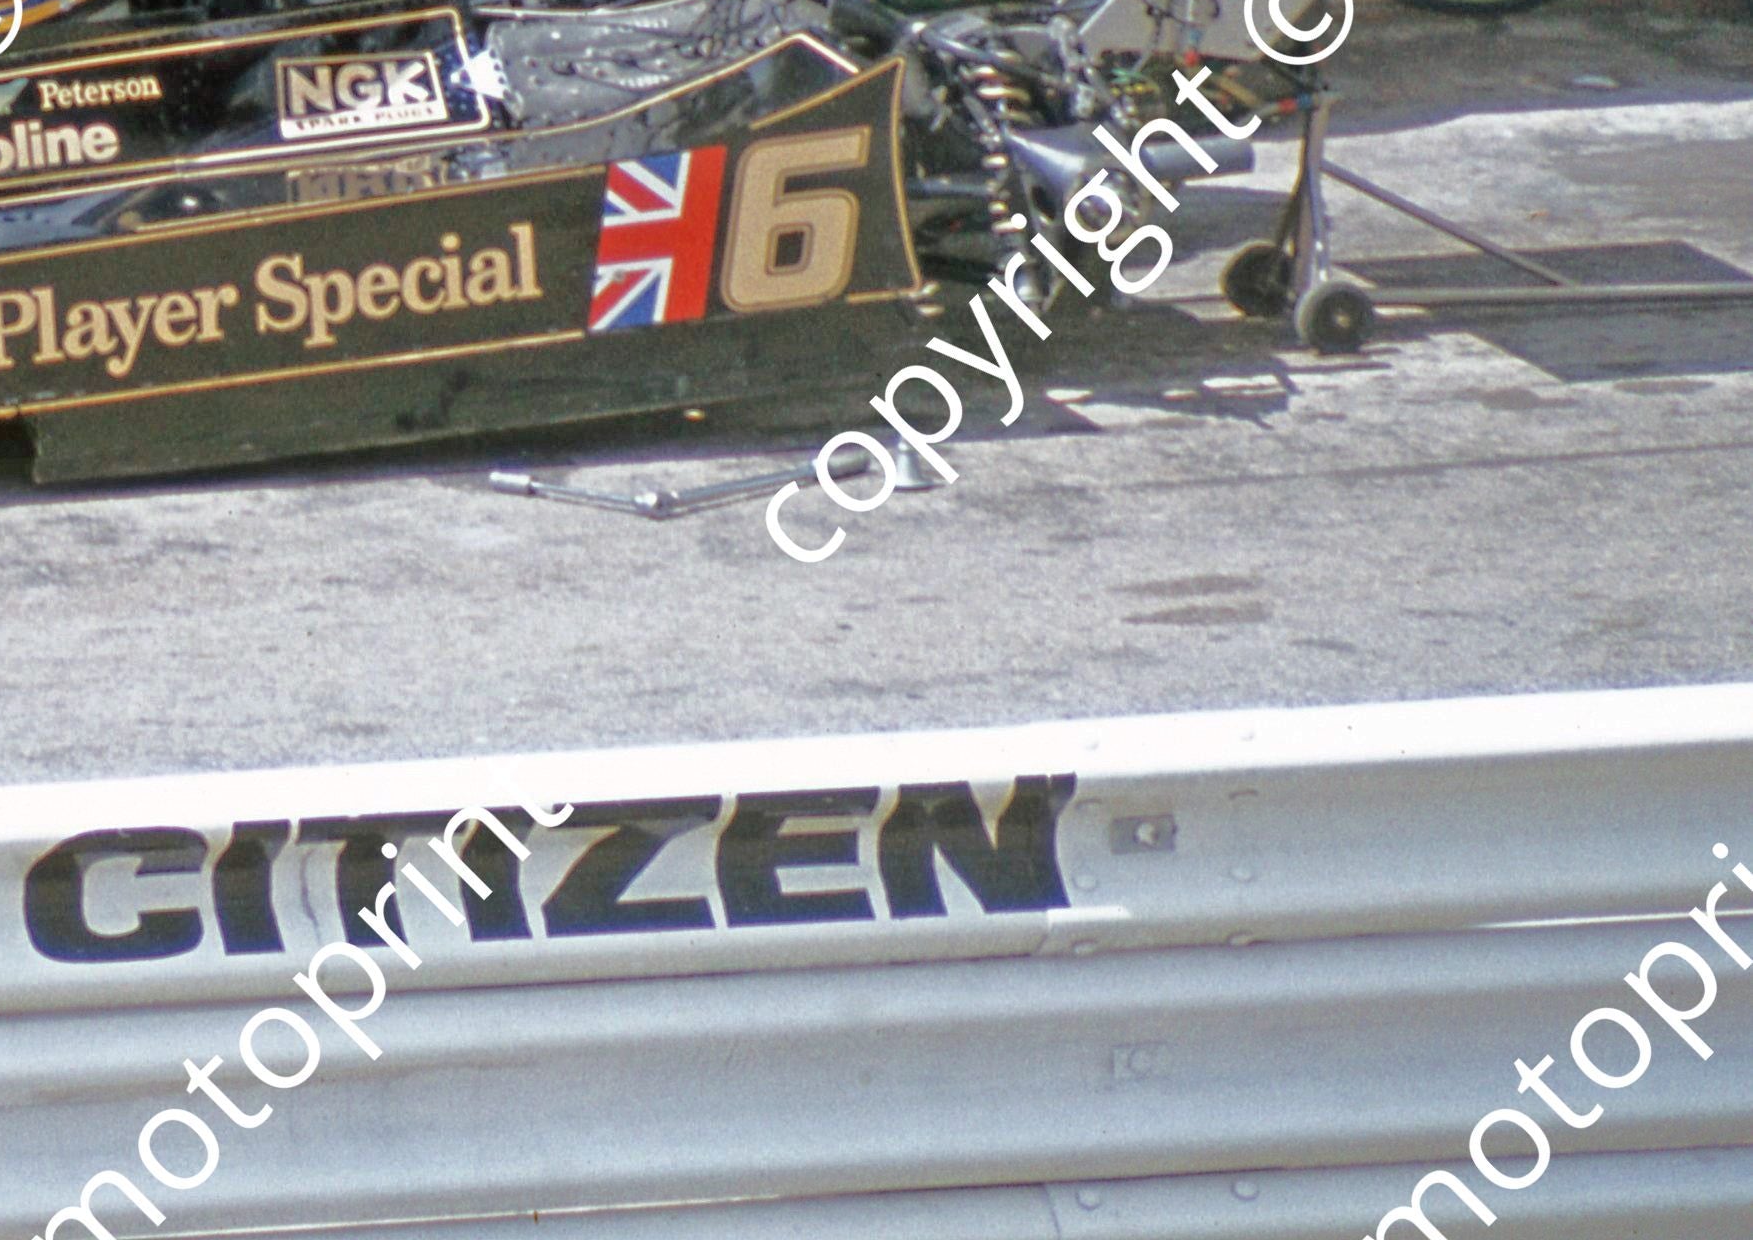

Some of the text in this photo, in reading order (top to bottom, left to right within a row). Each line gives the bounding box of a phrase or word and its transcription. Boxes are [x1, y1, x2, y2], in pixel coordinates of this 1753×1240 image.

[36, 74, 163, 111] Peterson
[287, 61, 430, 116] NGK
[720, 124, 872, 313] 6
[253, 222, 543, 348] Special
[22, 771, 1077, 964] CITIZEN
